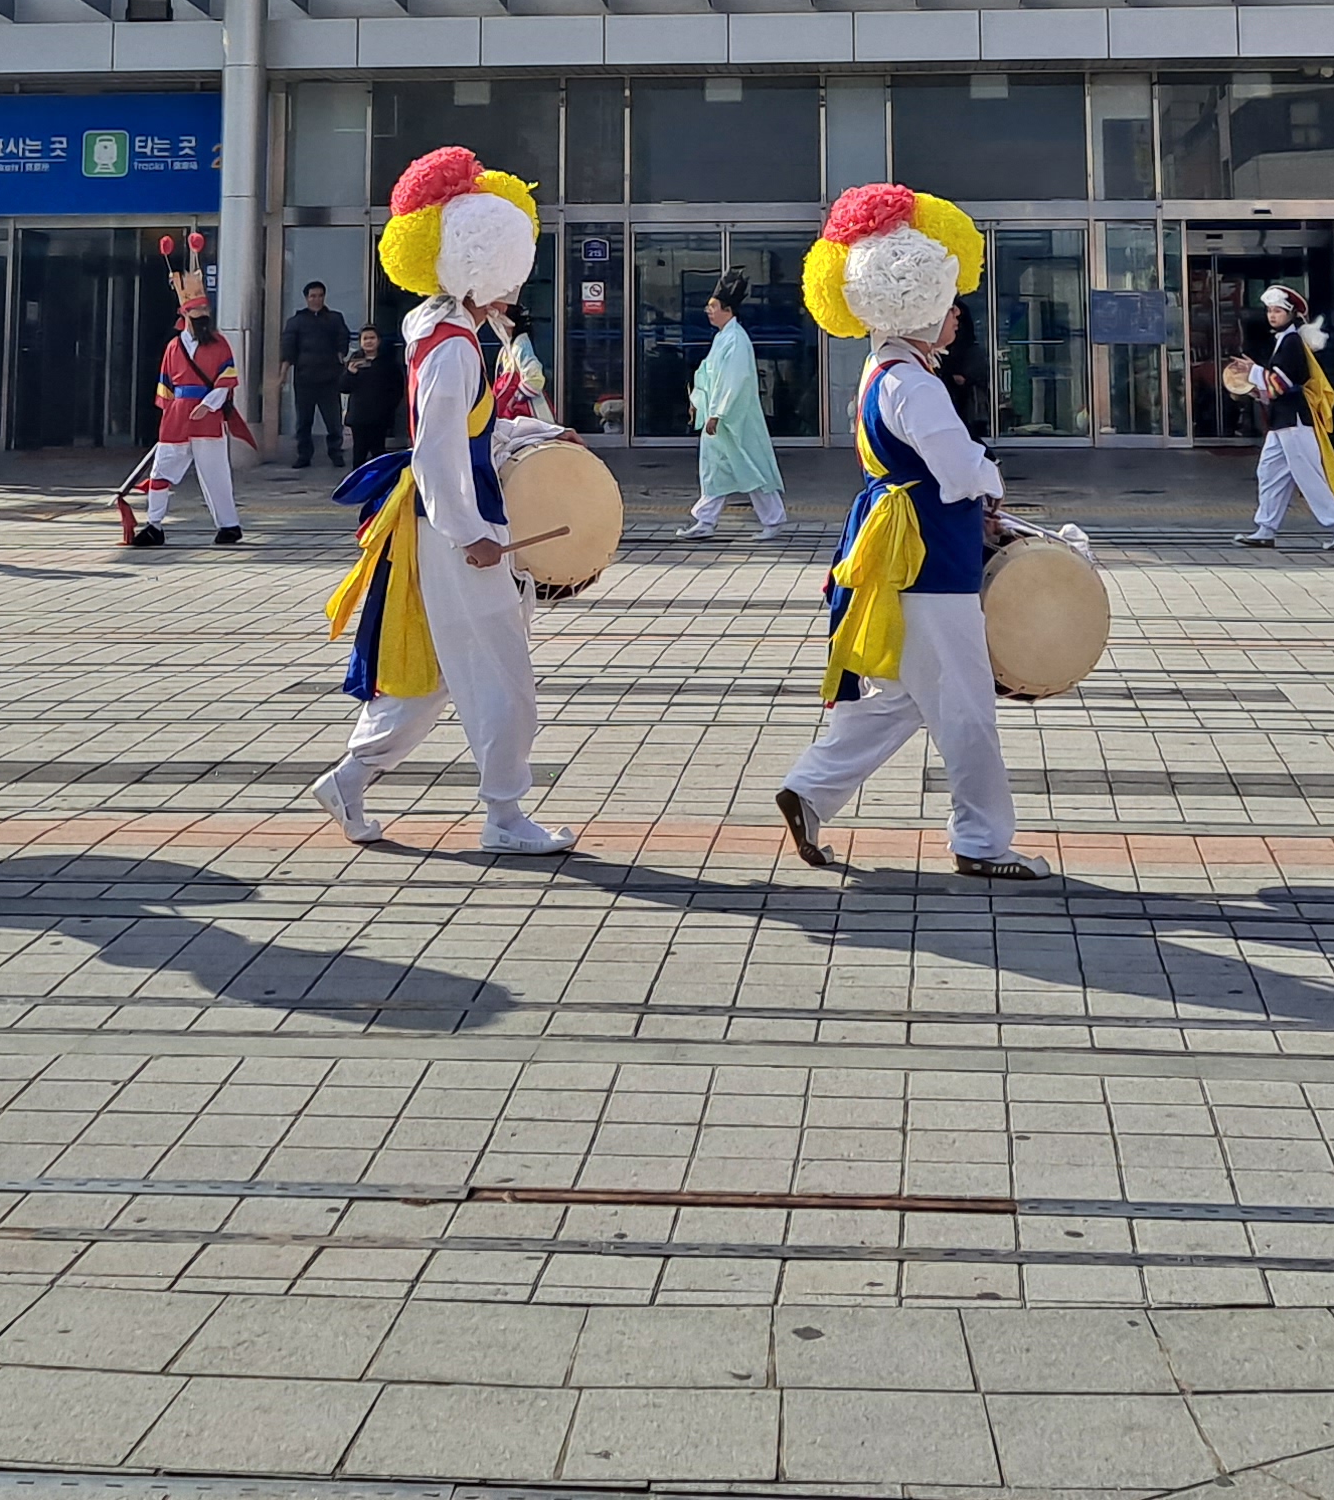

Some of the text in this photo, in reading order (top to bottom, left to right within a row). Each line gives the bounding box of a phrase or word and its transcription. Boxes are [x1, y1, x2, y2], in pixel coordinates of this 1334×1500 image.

[49, 136, 68, 157] 곳
[135, 136, 196, 156] 타는 곳
